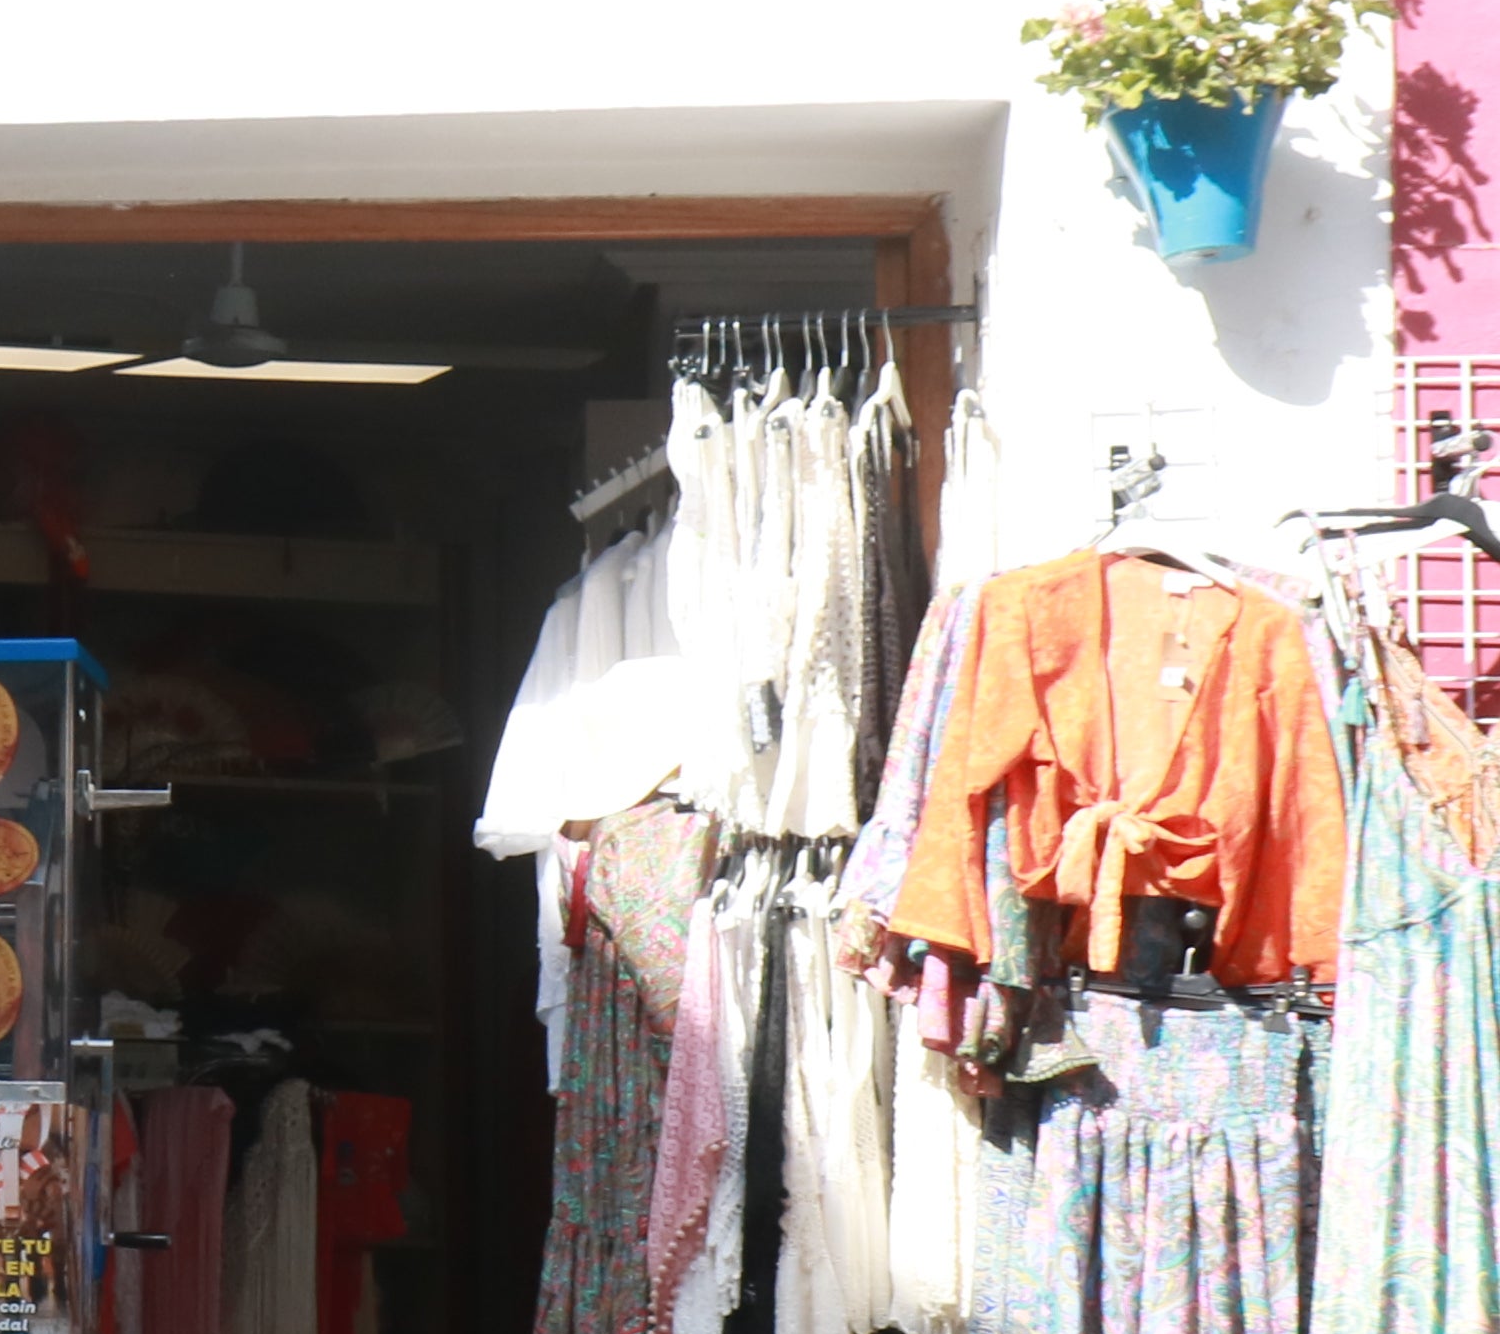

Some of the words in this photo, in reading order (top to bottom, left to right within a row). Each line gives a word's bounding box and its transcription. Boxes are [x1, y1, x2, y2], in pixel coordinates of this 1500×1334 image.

[21, 1239, 51, 1255] TU
[6, 1261, 35, 1276] EN
[0, 1300, 36, 1313] coin
